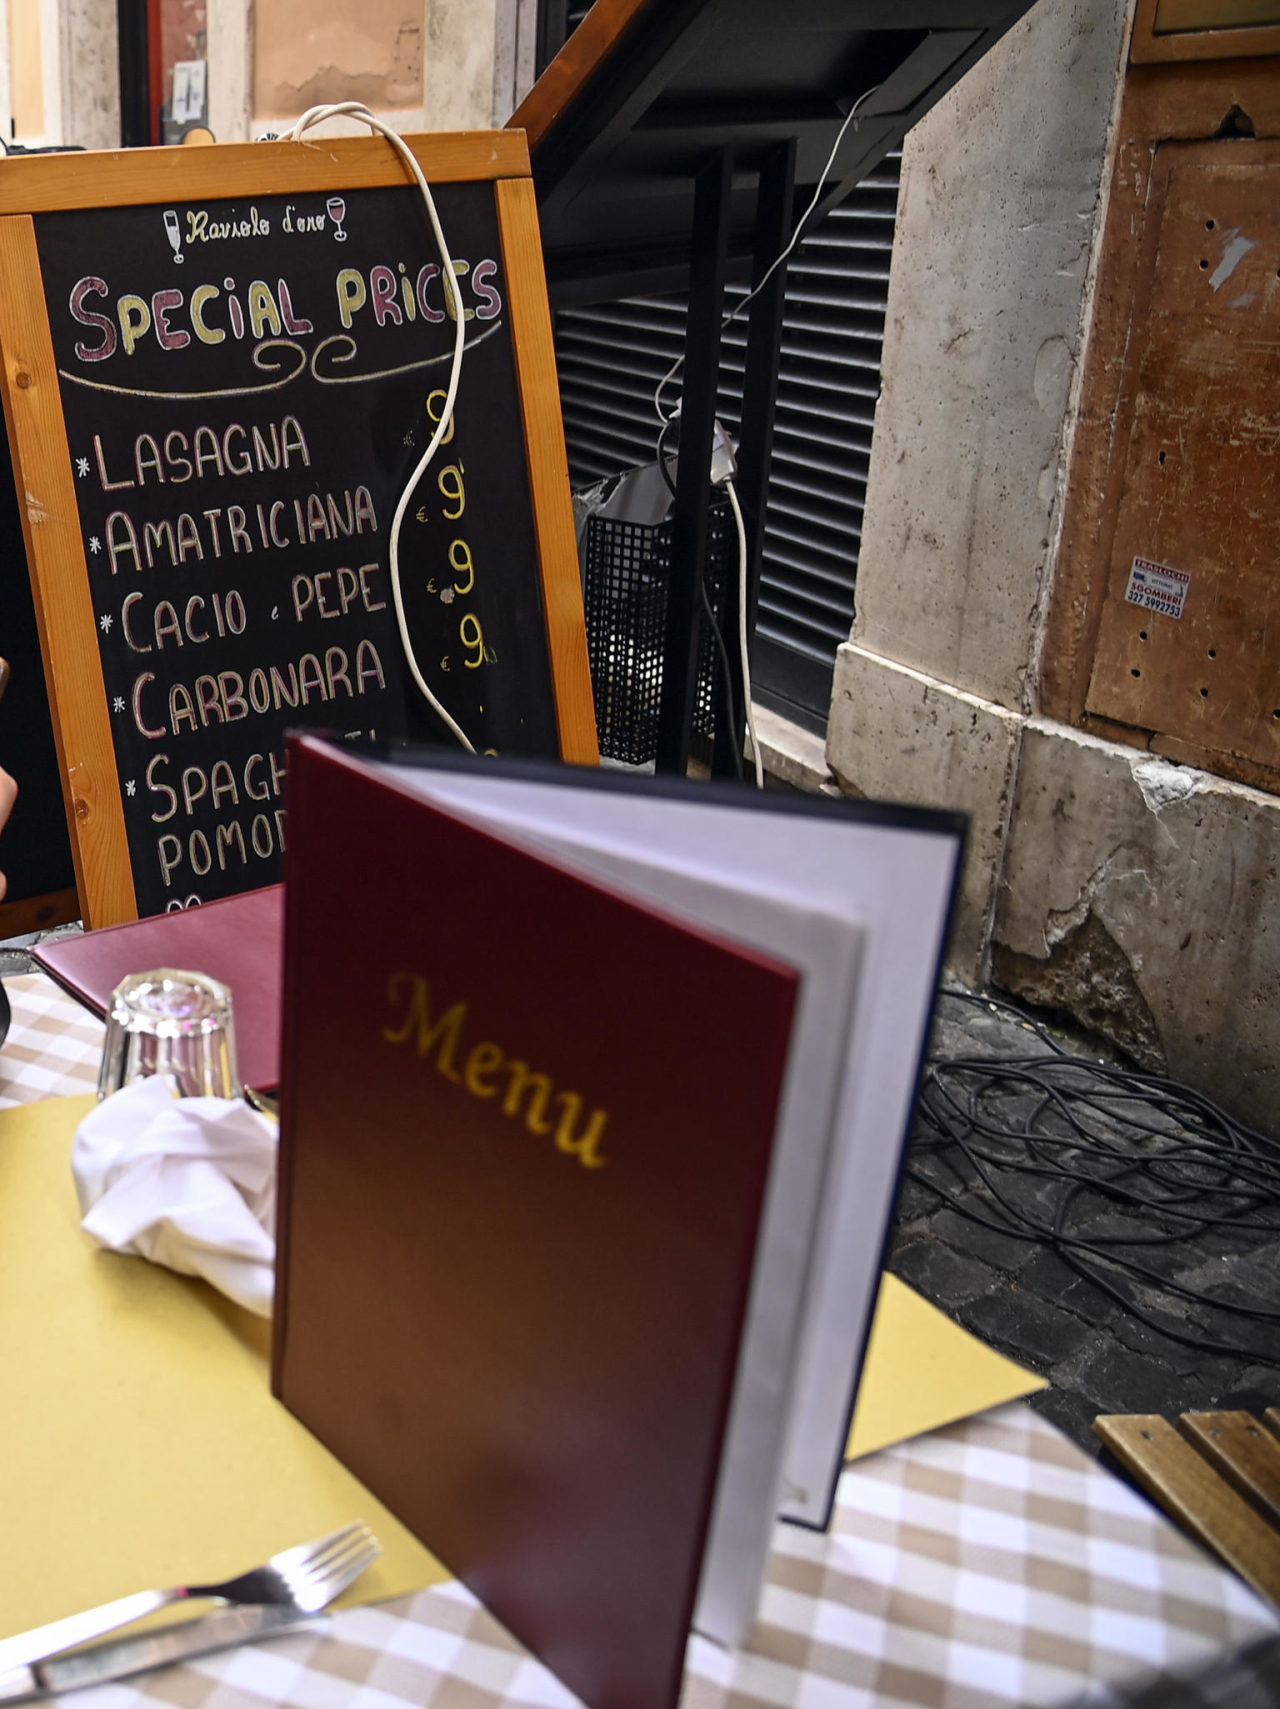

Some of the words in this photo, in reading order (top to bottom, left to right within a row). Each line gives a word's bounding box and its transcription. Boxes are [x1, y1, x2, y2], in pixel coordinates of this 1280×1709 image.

[186, 206, 269, 244] Raviolo
[283, 205, 326, 233] d'oro
[94, 415, 311, 491] LASAGNA
[105, 486, 378, 575] AMATRICIANA
[438, 465, 465, 520] 9
[122, 590, 247, 652] CACIO
[291, 563, 386, 622] PEPE
[448, 539, 475, 594] 9
[1128, 590, 1144, 603] 327
[1144, 597, 1181, 617] 5992753
[1131, 582, 1181, 605] SGOMBERI
[132, 639, 385, 739] CARBONARA
[460, 613, 484, 669] 9
[381, 970, 609, 1169] Menu
